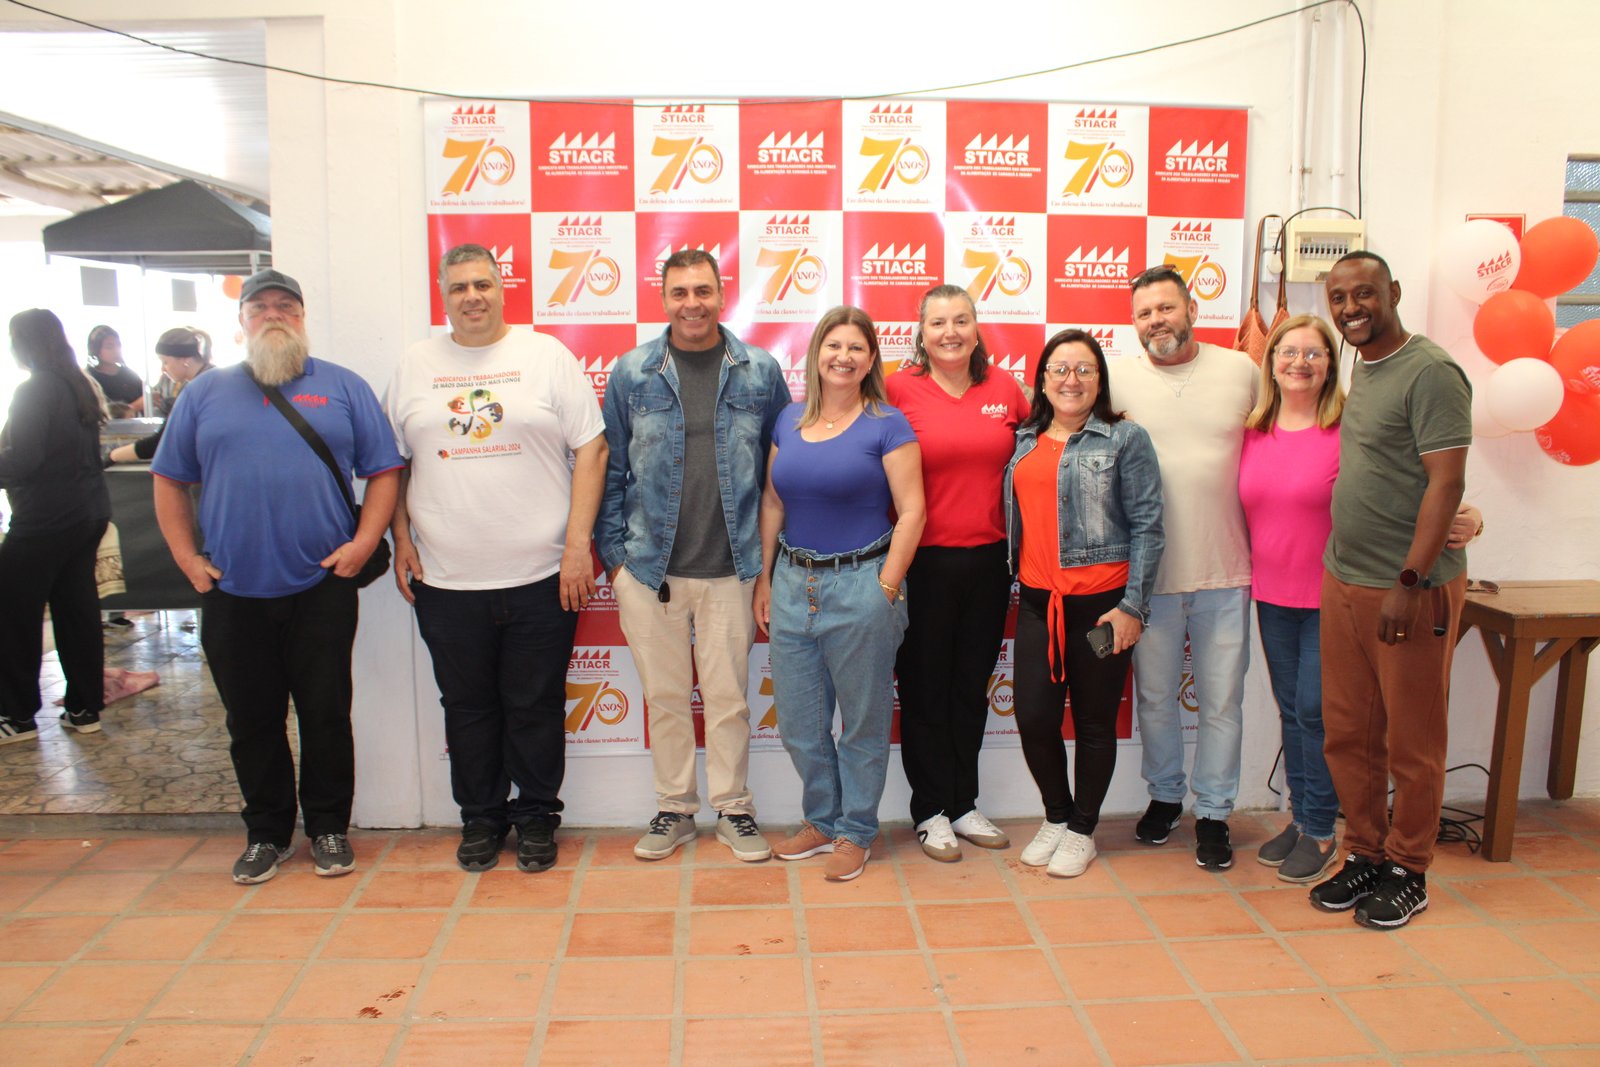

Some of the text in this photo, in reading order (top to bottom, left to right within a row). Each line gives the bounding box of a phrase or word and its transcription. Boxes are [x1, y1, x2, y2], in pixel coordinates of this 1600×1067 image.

[452, 116, 496, 124] STIACR
[661, 114, 704, 123] STIACR
[870, 115, 912, 124] STIACR
[1074, 120, 1116, 128] STIACR
[549, 150, 615, 164] STIACR
[758, 149, 824, 162] STIACR
[965, 152, 1029, 165] STIACR
[482, 162, 510, 170] ANOS
[690, 160, 718, 169] ANOS
[898, 160, 924, 170] ANOS
[1102, 164, 1128, 174] ANOS
[1165, 157, 1228, 171] STIACR
[558, 228, 602, 236] STIACR
[766, 226, 810, 234] STIACR
[1170, 232, 1211, 242] STIACR
[862, 261, 926, 274] STIACR
[1065, 264, 1128, 278] STIACR
[1477, 256, 1512, 278] STIACR
[588, 272, 615, 281] ANOS
[794, 270, 821, 280] ANOS
[999, 271, 1026, 281] ANOS
[1196, 277, 1220, 286] ANOS
[878, 337, 912, 346] TIACR
[568, 660, 610, 669] STIACR
[596, 702, 624, 712] ANOS
